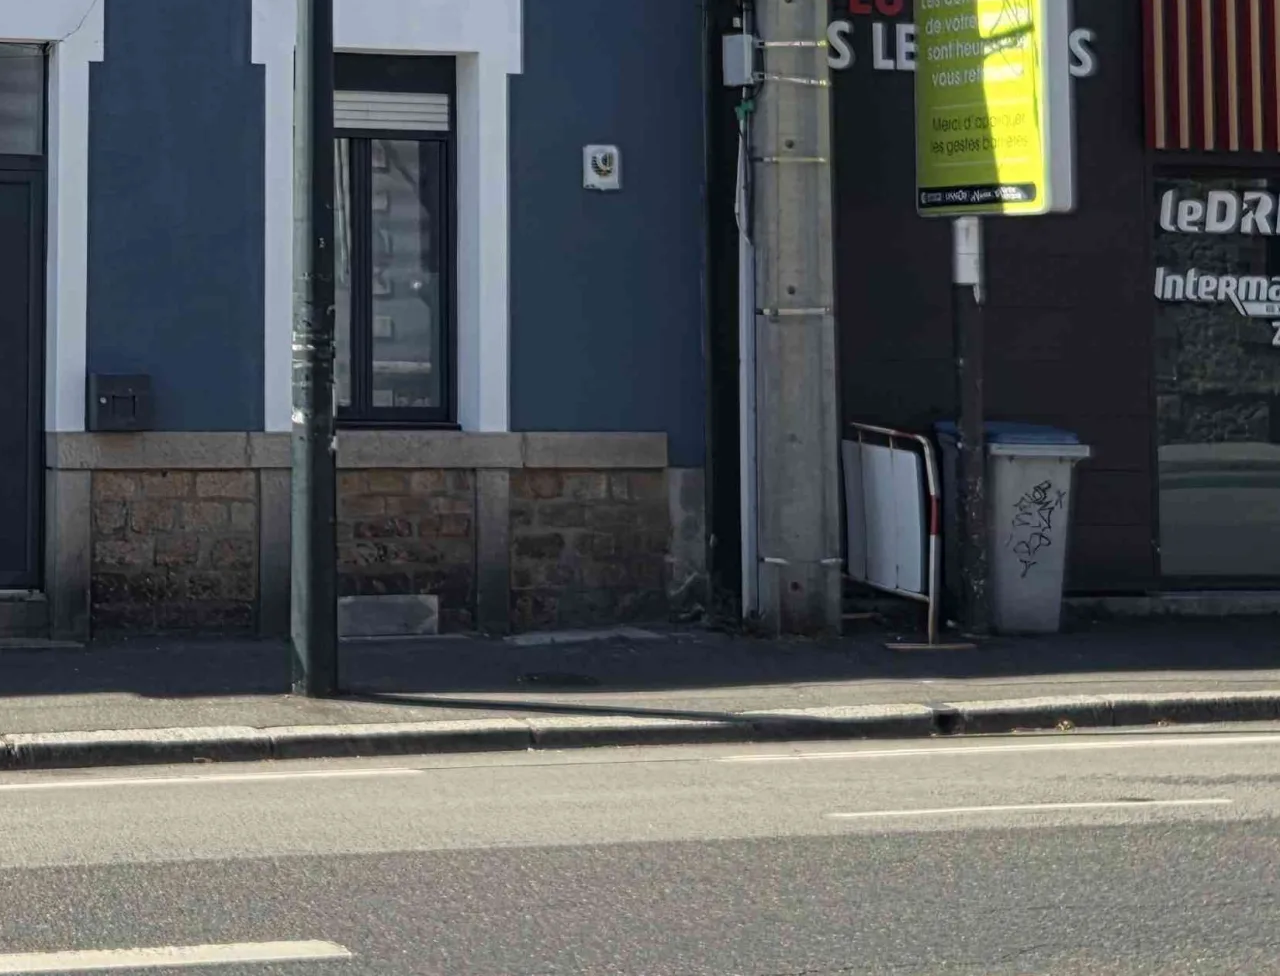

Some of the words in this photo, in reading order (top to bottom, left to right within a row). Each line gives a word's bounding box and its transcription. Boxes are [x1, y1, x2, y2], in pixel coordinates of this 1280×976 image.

[925, 18, 941, 35] de
[946, 12, 978, 32] votre
[927, 40, 955, 61] sont
[931, 70, 961, 88] vous
[1159, 188, 1280, 236] leDR
